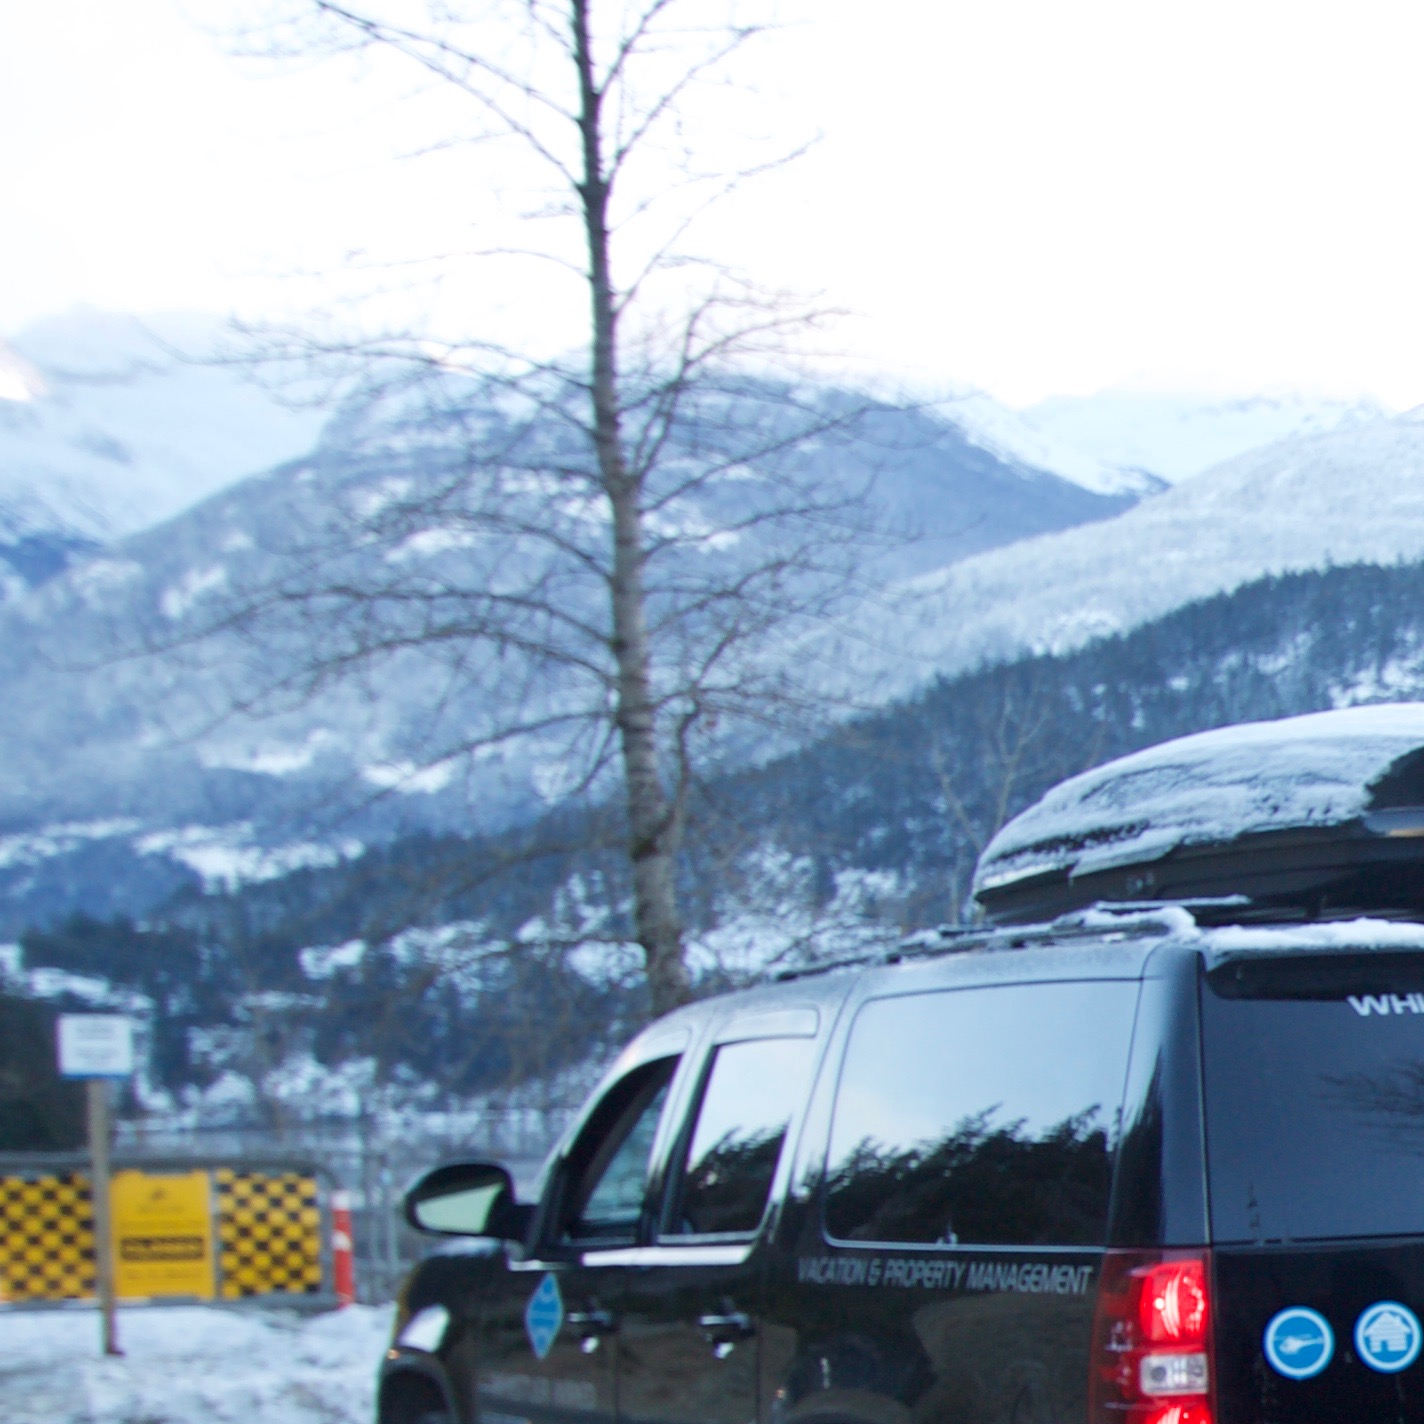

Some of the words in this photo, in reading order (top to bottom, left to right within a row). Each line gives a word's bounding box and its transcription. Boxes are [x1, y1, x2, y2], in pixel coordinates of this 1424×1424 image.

[798, 1256, 866, 1286] VACATION
[883, 1257, 966, 1289] PROPERTY
[966, 1261, 1094, 1296] MANAGEMENT
